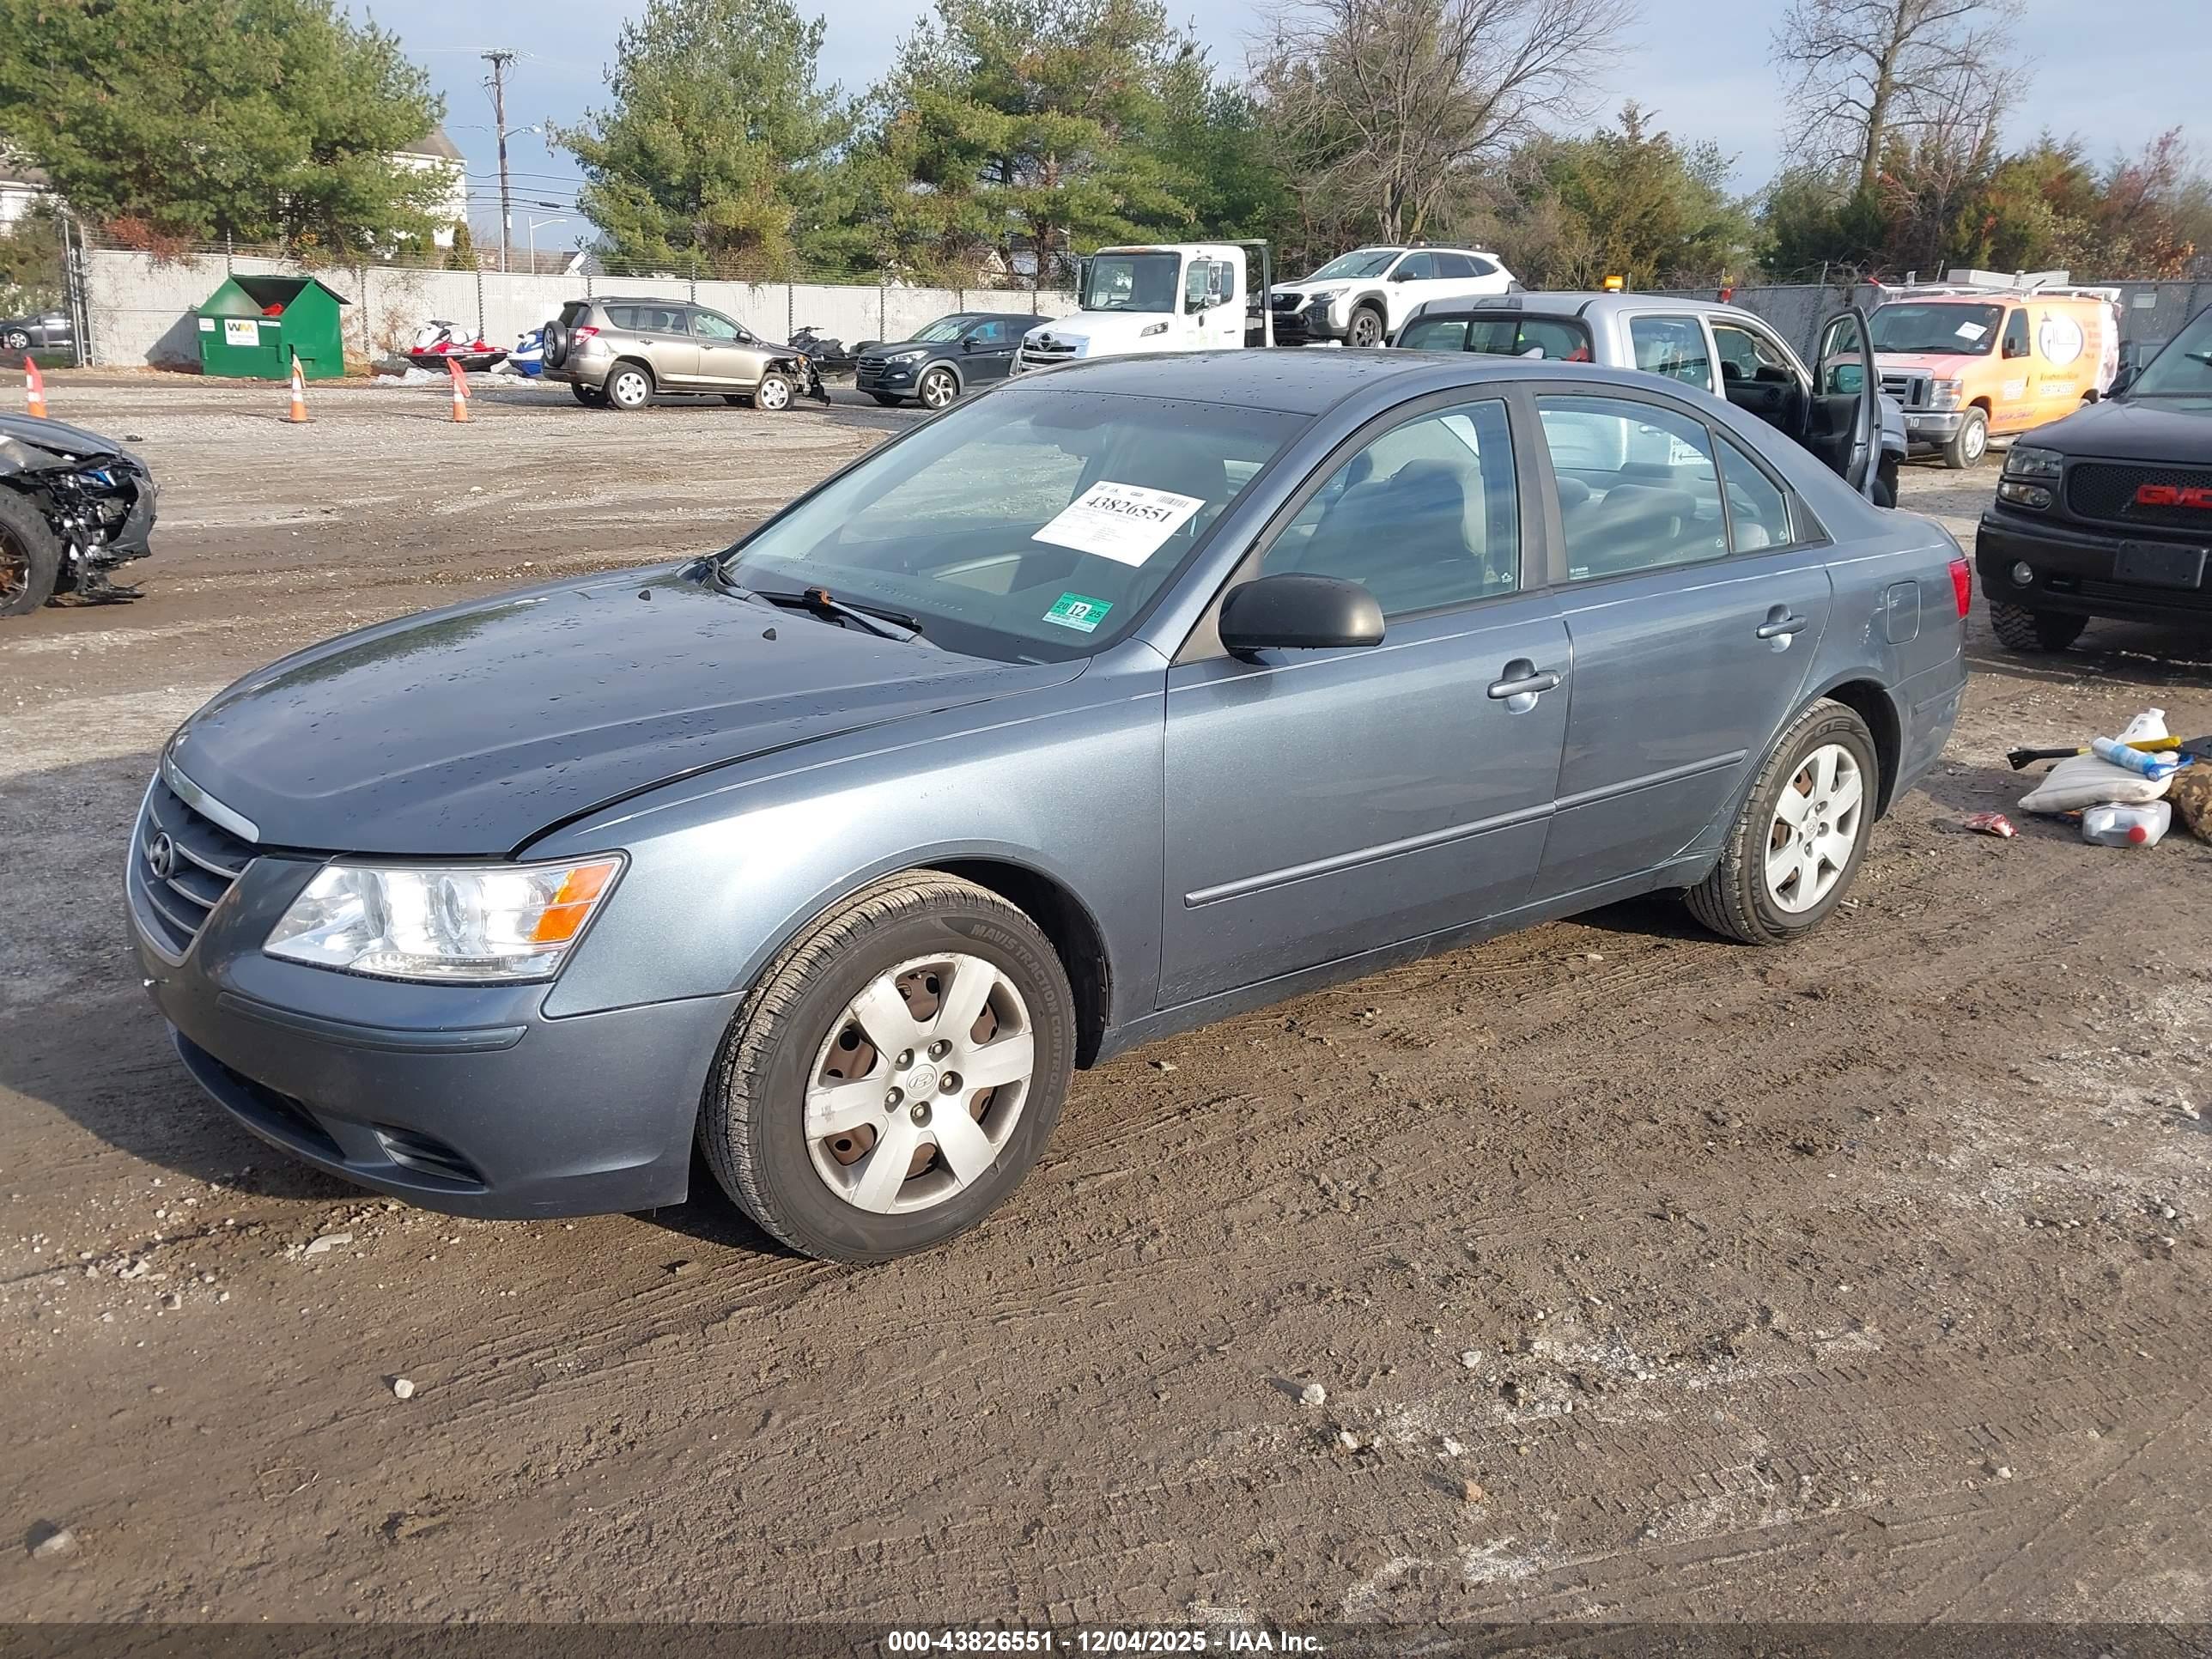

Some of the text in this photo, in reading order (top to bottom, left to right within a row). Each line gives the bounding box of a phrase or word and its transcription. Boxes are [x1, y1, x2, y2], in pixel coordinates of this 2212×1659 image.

[228, 322, 254, 332] WM
[1909, 417, 1920, 428] 10
[2137, 484, 2212, 508] GMC
[1086, 495, 1173, 522] 43826551
[1068, 604, 1087, 617] 12
[970, 924, 1063, 1093] MAVIS TRACTION CONTROL
